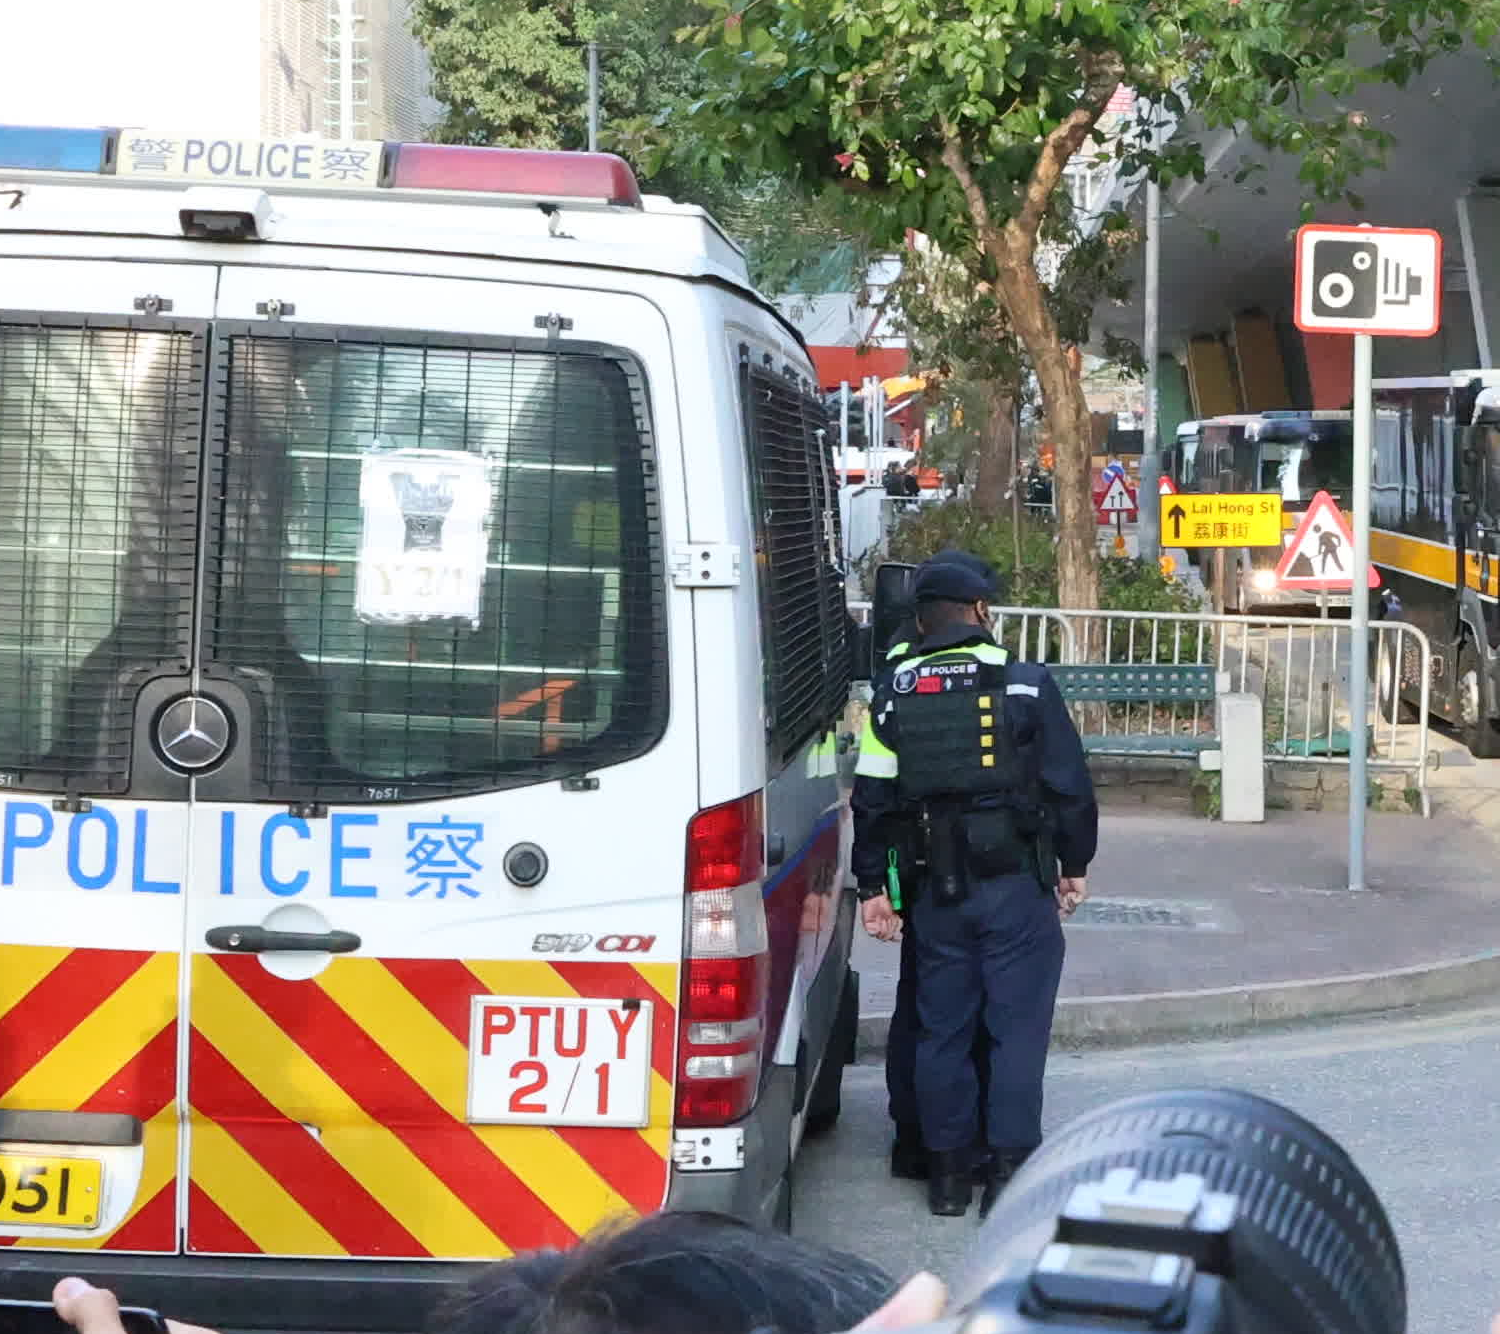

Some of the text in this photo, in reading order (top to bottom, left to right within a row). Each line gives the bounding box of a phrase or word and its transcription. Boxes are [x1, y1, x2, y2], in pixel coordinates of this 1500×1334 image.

[128, 138, 371, 180] 警 POLICE 察
[1191, 501, 1277, 517] Lai Hong St
[931, 665, 967, 676] POLICE
[367, 786, 399, 801] 7051
[0, 801, 381, 898] POLICE
[405, 814, 485, 899] 察
[595, 933, 657, 953] CDI
[481, 1005, 641, 1060] PTU Y
[508, 1060, 610, 1116] 2/1
